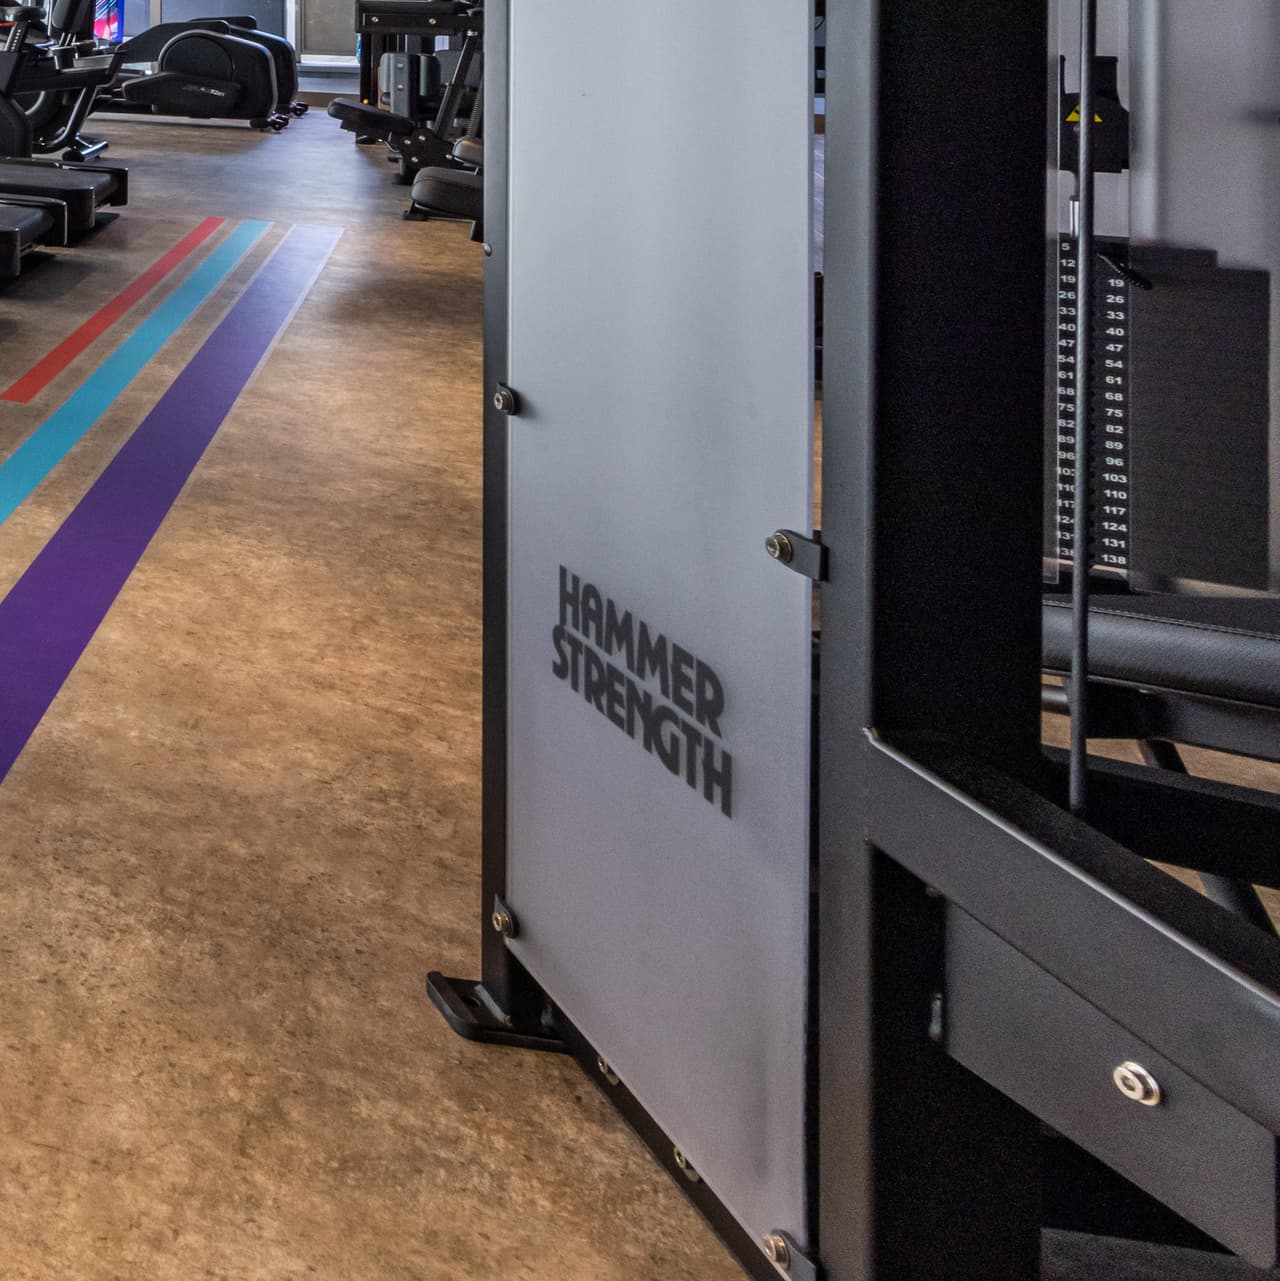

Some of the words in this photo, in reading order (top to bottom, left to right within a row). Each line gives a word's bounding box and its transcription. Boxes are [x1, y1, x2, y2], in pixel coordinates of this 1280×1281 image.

[1061, 243, 1071, 251] 5
[1060, 259, 1076, 267] 12
[1060, 275, 1076, 283] 19
[1108, 279, 1124, 287] 19
[1058, 291, 1076, 299] 26
[1106, 295, 1125, 304] 26
[1059, 307, 1076, 315] 33
[1106, 311, 1125, 320] 33
[1058, 323, 1076, 331] 40
[1105, 328, 1124, 336] 40
[1058, 339, 1075, 347] 47
[1105, 344, 1124, 352] 47
[1058, 355, 1075, 363] 54
[1105, 359, 1123, 369] 54
[1057, 371, 1074, 379] 61
[1105, 376, 1122, 385] 61
[1057, 387, 1075, 396] 68
[1105, 392, 1123, 401] 68
[1058, 403, 1075, 412] 75
[1105, 408, 1123, 417] 75
[1057, 419, 1075, 428] 82
[1105, 424, 1124, 434] 82
[1057, 435, 1075, 444] 89
[1105, 441, 1124, 450] 89
[1057, 451, 1075, 460] 96
[1105, 457, 1124, 466] 96
[1102, 473, 1127, 483] 103
[1104, 489, 1127, 499] 110
[1103, 506, 1127, 515] 117
[1102, 522, 1128, 532] 124
[1102, 538, 1126, 548] 131
[1101, 554, 1127, 565] 138
[559, 564, 724, 739] HAMMER
[552, 624, 732, 819] STRENGTH
